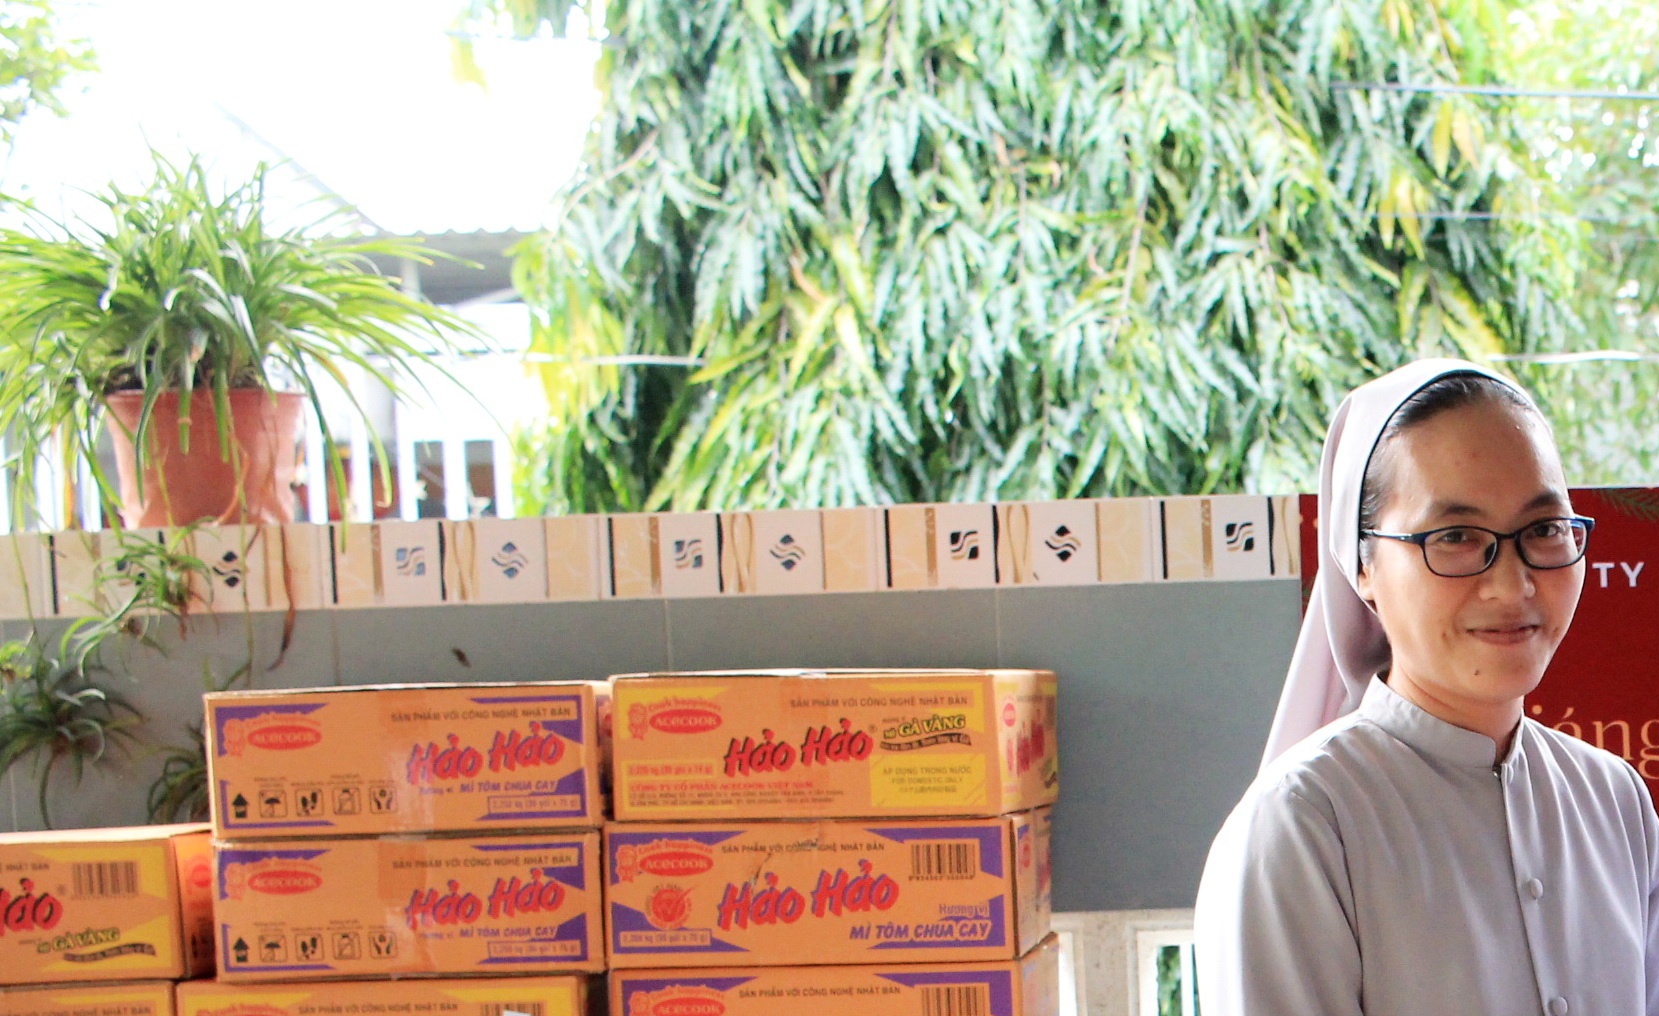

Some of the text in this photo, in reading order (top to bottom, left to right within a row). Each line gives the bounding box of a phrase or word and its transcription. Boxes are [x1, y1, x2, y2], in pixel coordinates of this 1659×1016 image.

[1593, 562, 1645, 588] TY
[899, 715, 965, 737] GÀ VÀNG
[724, 719, 874, 777] Hảo Hảo
[718, 859, 899, 932] Hảo Hảo
[873, 922, 908, 940] TÔM
[912, 922, 955, 938] CHUA
[959, 921, 991, 937] CAY
